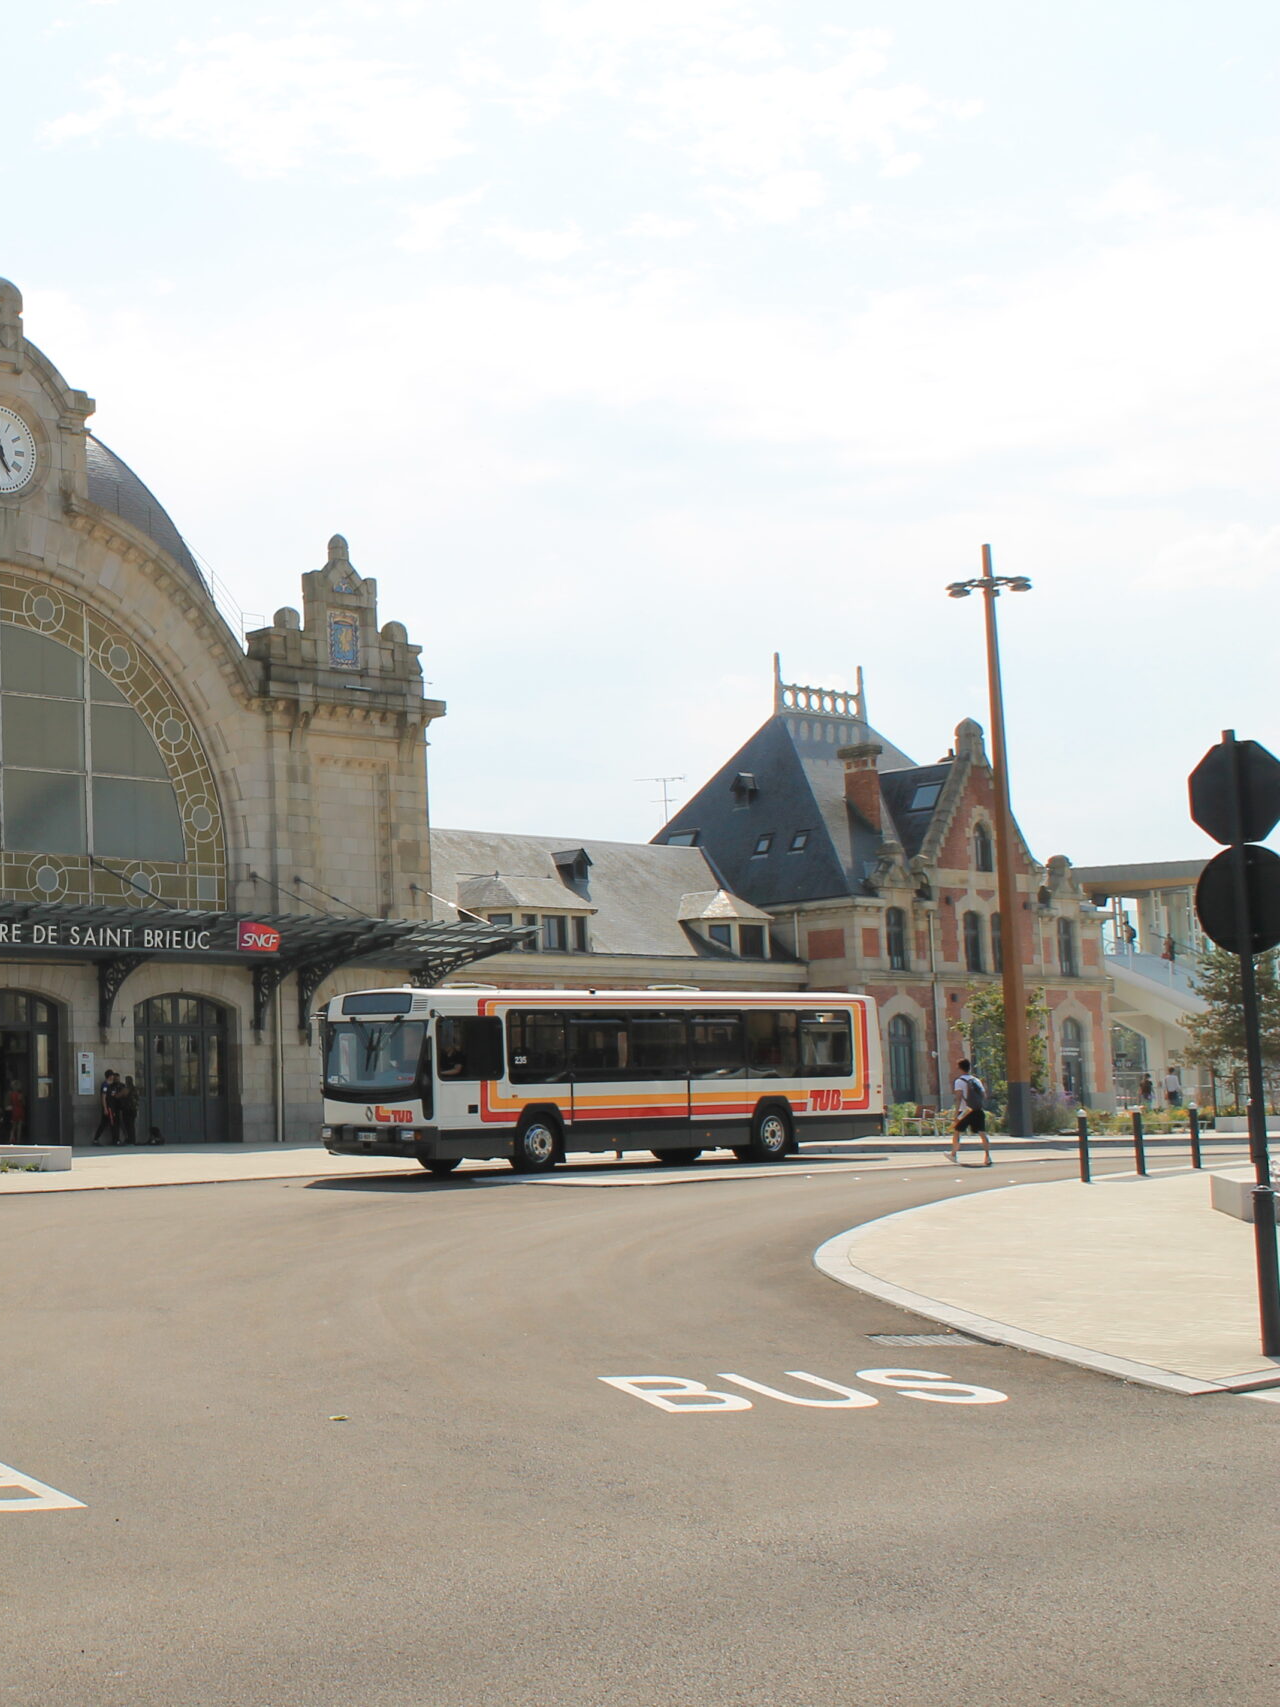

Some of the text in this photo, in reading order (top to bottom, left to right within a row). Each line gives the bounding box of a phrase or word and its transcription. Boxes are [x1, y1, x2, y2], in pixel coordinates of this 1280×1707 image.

[32, 924, 58, 945] DE
[69, 926, 133, 948] SAINT
[143, 929, 211, 950] BRIEUC
[240, 932, 280, 948] SNCF
[809, 1089, 843, 1112] TUB
[596, 1368, 1009, 1413] BUS
